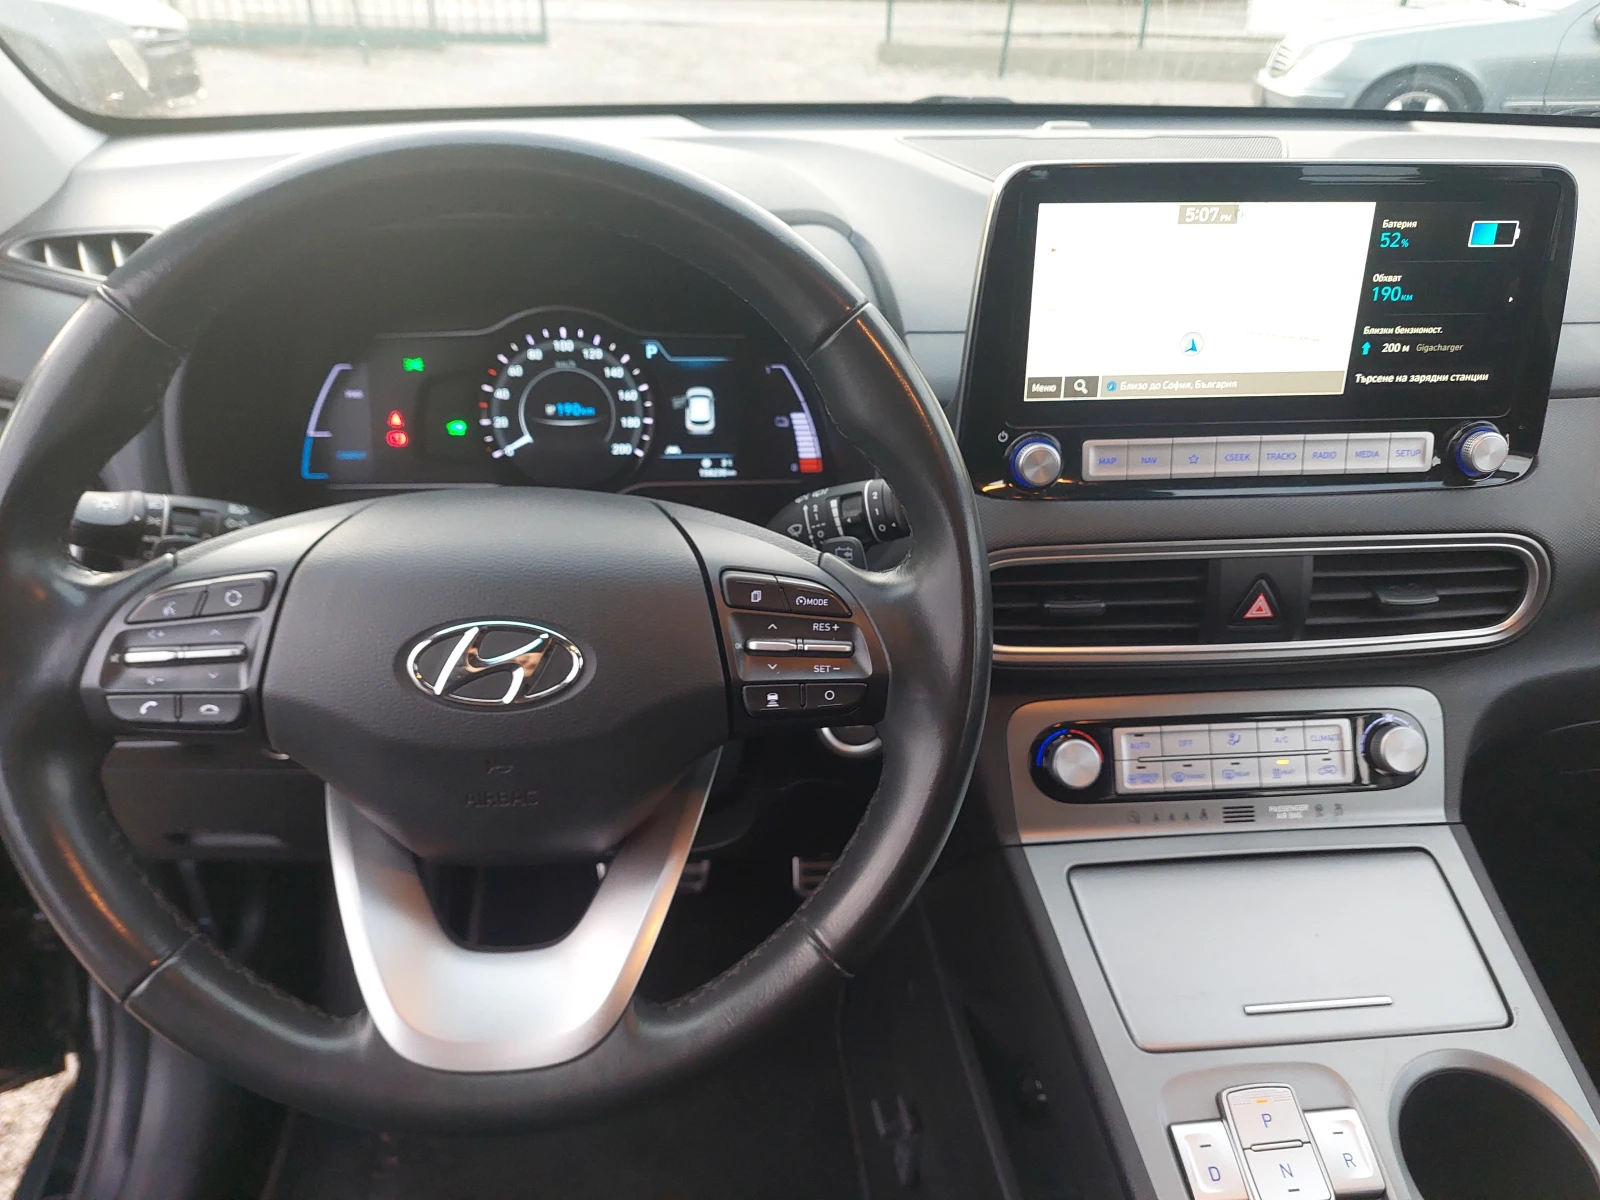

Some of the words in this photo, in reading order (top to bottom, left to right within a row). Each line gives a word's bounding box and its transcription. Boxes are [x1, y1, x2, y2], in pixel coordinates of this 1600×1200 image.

[1184, 206, 1220, 223] 5:07
[1382, 219, 1418, 229] Батерия
[1372, 273, 1403, 283] Обхват
[1363, 326, 1394, 335] Близки
[1394, 325, 1444, 334] бензионост.
[552, 339, 575, 353] 100
[644, 343, 658, 359] P
[1381, 342, 1401, 353] 200
[1416, 343, 1464, 354] Gigacharger
[582, 348, 604, 361] 120
[604, 366, 625, 379] 140
[1119, 380, 1148, 391] Близо
[1149, 382, 1161, 391] до
[1162, 378, 1193, 391] София,
[1194, 379, 1238, 390] България
[1355, 373, 1394, 385] Търсене
[1395, 374, 1408, 383] на
[1409, 374, 1449, 384] зарядни
[1450, 373, 1489, 383] станции
[1031, 382, 1057, 393] Меню
[492, 416, 509, 429] 20
[610, 442, 633, 456] 200
[1354, 450, 1380, 459] MEDIA
[1395, 449, 1422, 458] SETUP
[1098, 457, 1118, 466] MAP
[1140, 456, 1158, 465] NAV
[1312, 451, 1337, 460] RADIO
[872, 491, 879, 500] 2
[806, 598, 829, 607] MODE
[1269, 804, 1309, 813] PASSENGER
[1261, 1113, 1273, 1129] P
[1342, 1152, 1357, 1168] R
[1208, 1166, 1221, 1182] D
[1279, 1163, 1294, 1178] N
